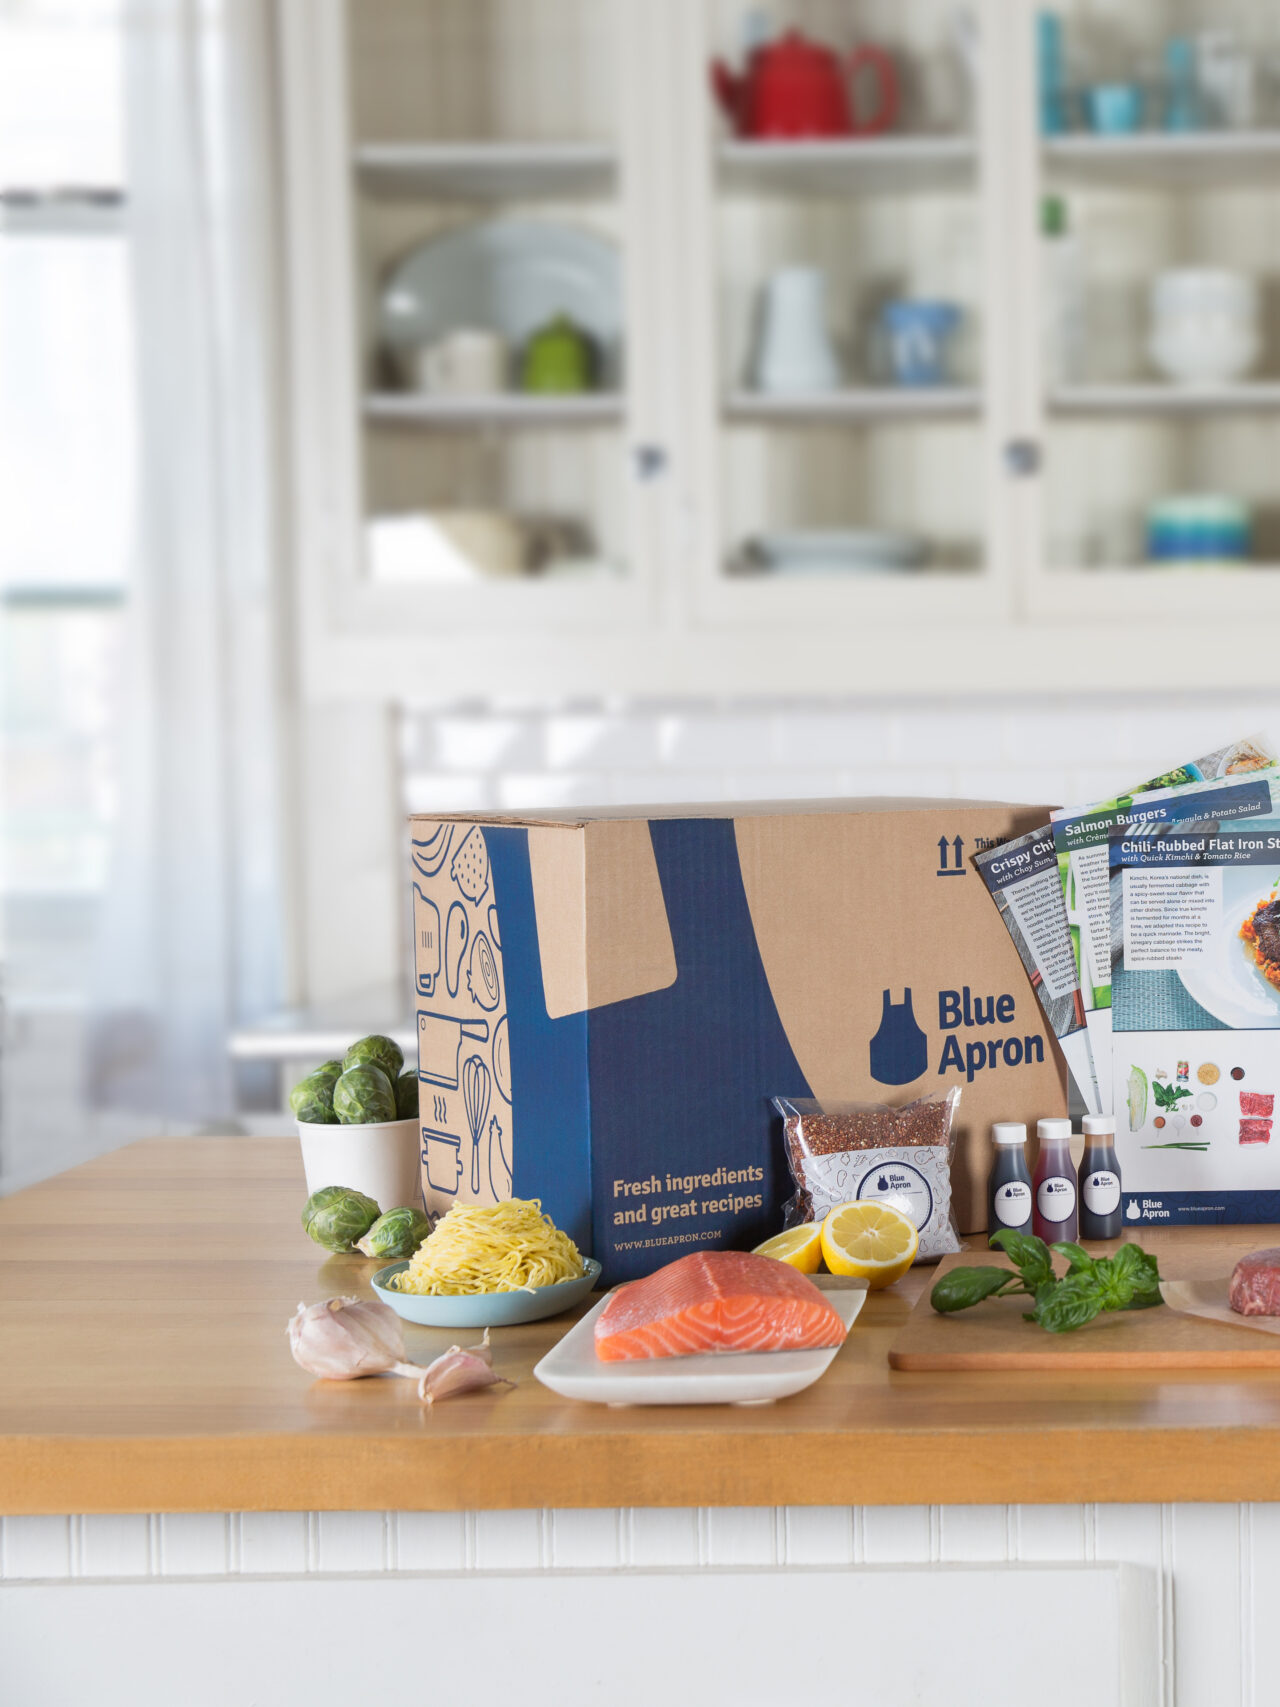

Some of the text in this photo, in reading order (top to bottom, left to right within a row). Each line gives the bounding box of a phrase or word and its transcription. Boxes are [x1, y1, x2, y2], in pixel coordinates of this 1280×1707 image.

[1065, 808, 1166, 836] Salmon Burgers
[1067, 837, 1083, 846] with
[1212, 808, 1236, 818] Potato
[1238, 802, 1261, 812] Salad
[974, 838, 994, 848] This
[991, 851, 1030, 873] Crispy
[1033, 839, 1056, 855] Chi
[1121, 840, 1204, 853] Chili-Rubbed
[1210, 839, 1234, 850] Flat
[1238, 839, 1263, 850] Iron
[996, 857, 1053, 884] with Choy Sum,
[938, 986, 1015, 1030] Blue
[938, 1034, 1044, 1082] Apron
[614, 1165, 764, 1198] Fresh ingredients
[614, 1194, 763, 1226] and great recipes
[1142, 1200, 1162, 1209] Blue
[1142, 1208, 1170, 1219] Apron
[614, 1230, 722, 1251] WWW.BLUEAPRON.COM
